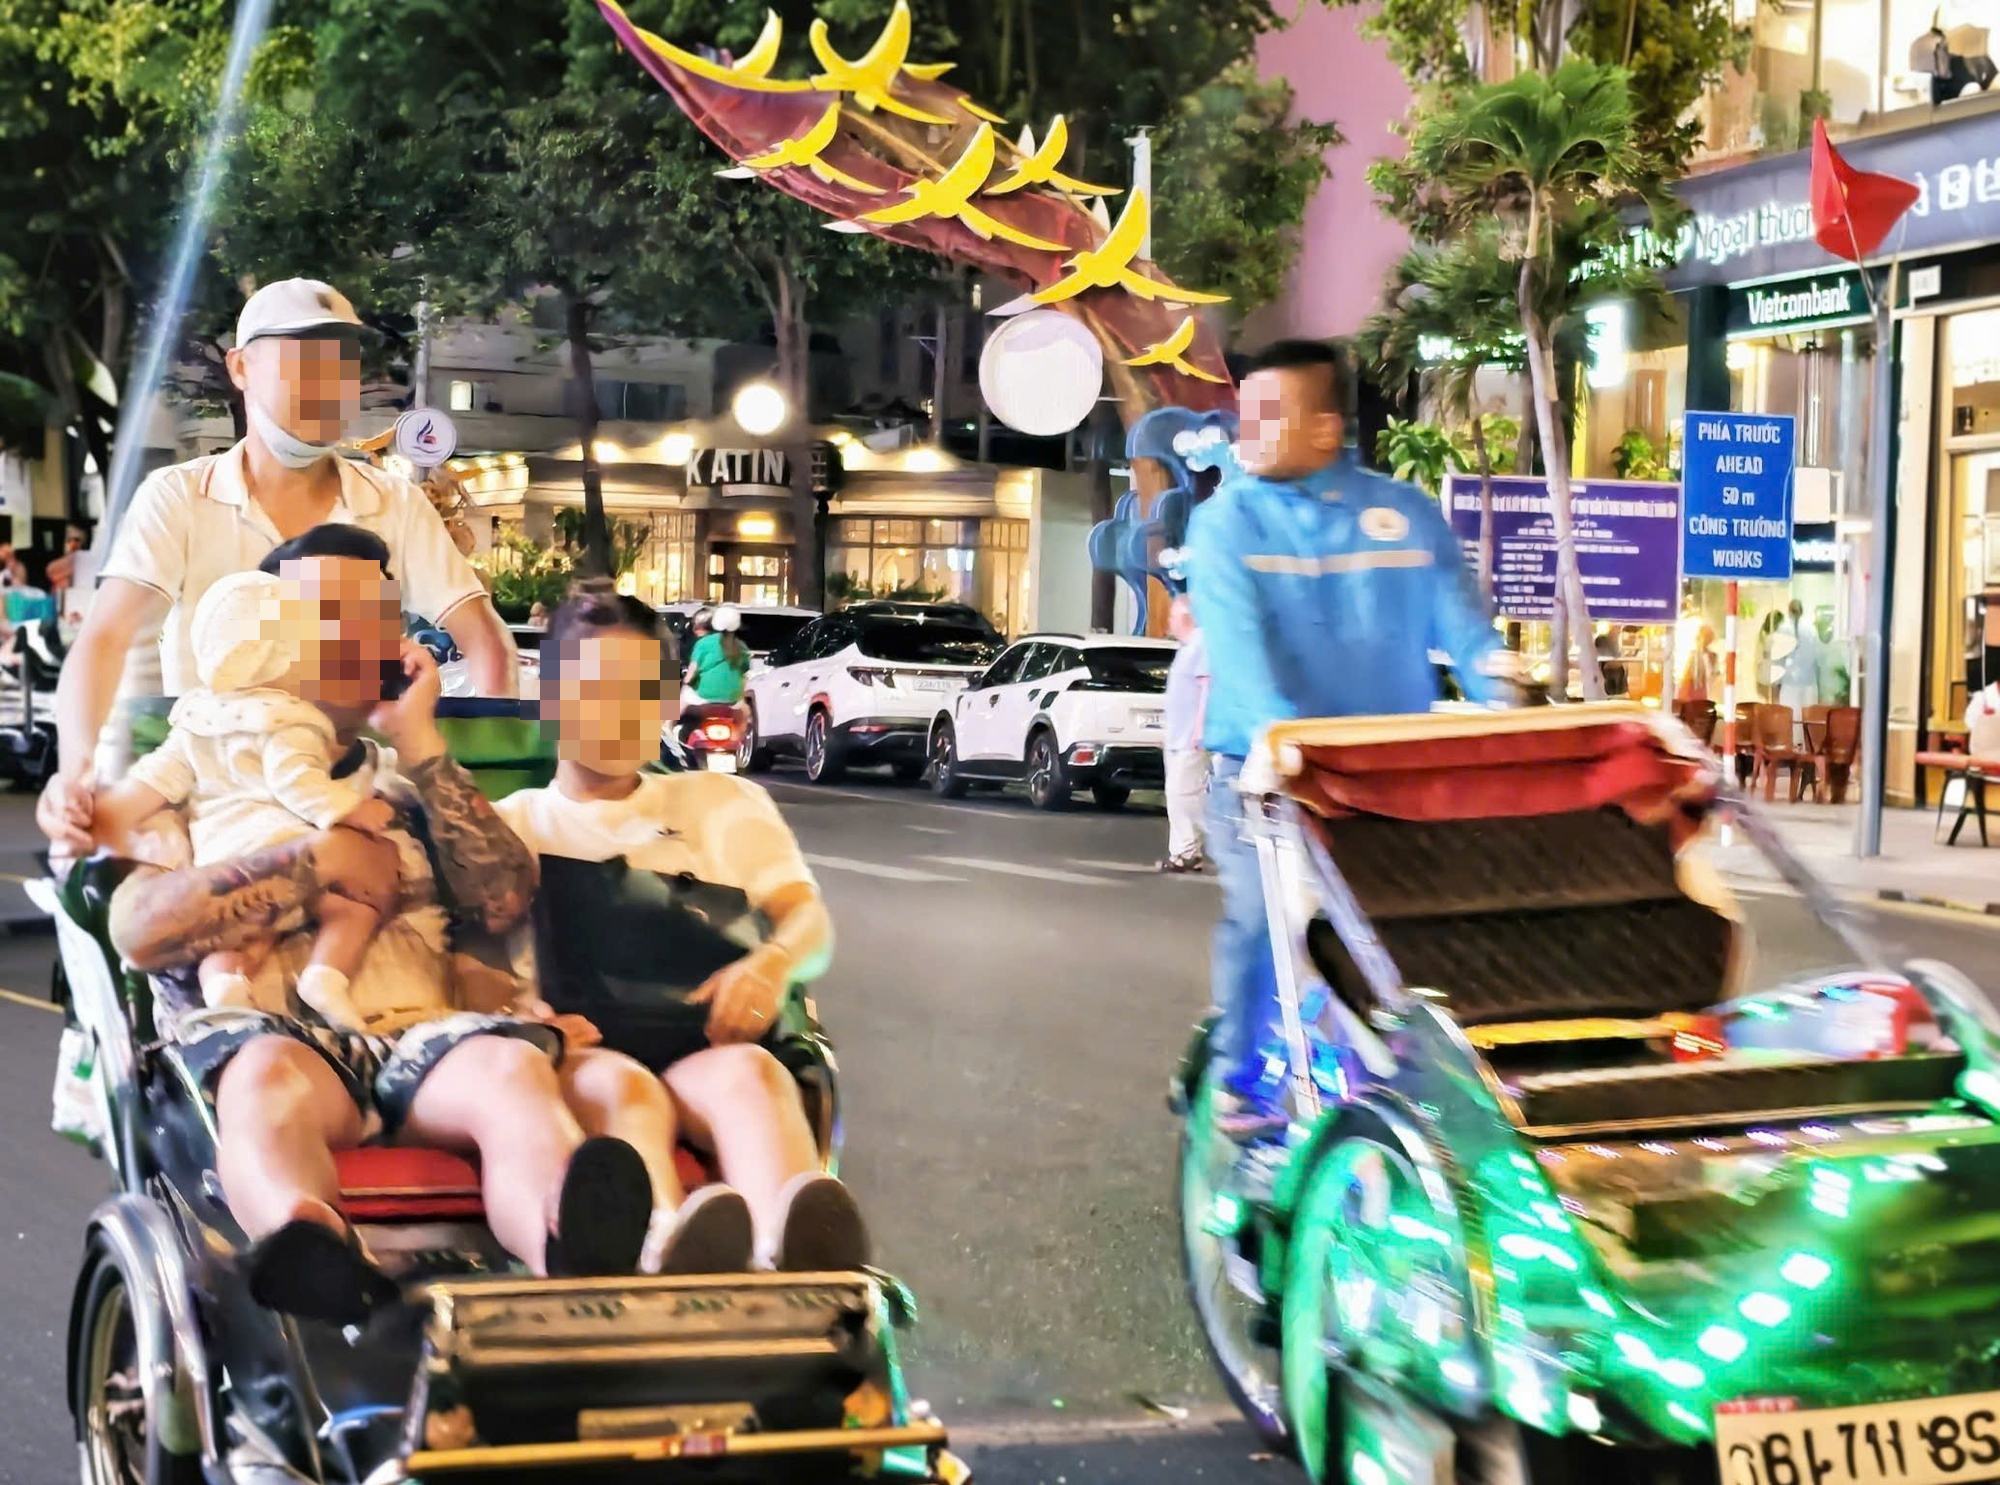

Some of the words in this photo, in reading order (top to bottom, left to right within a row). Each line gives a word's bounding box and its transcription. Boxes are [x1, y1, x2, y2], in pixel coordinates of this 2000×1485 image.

[1747, 277, 1850, 324] Vietcombank
[1698, 420, 1731, 441] PHÍA
[1716, 455, 1762, 475] AHEAD
[1723, 486, 1739, 505] 50
[1742, 492, 1755, 506] m
[1689, 514, 1727, 535] CÔNG
[1713, 549, 1763, 568] WORKS
